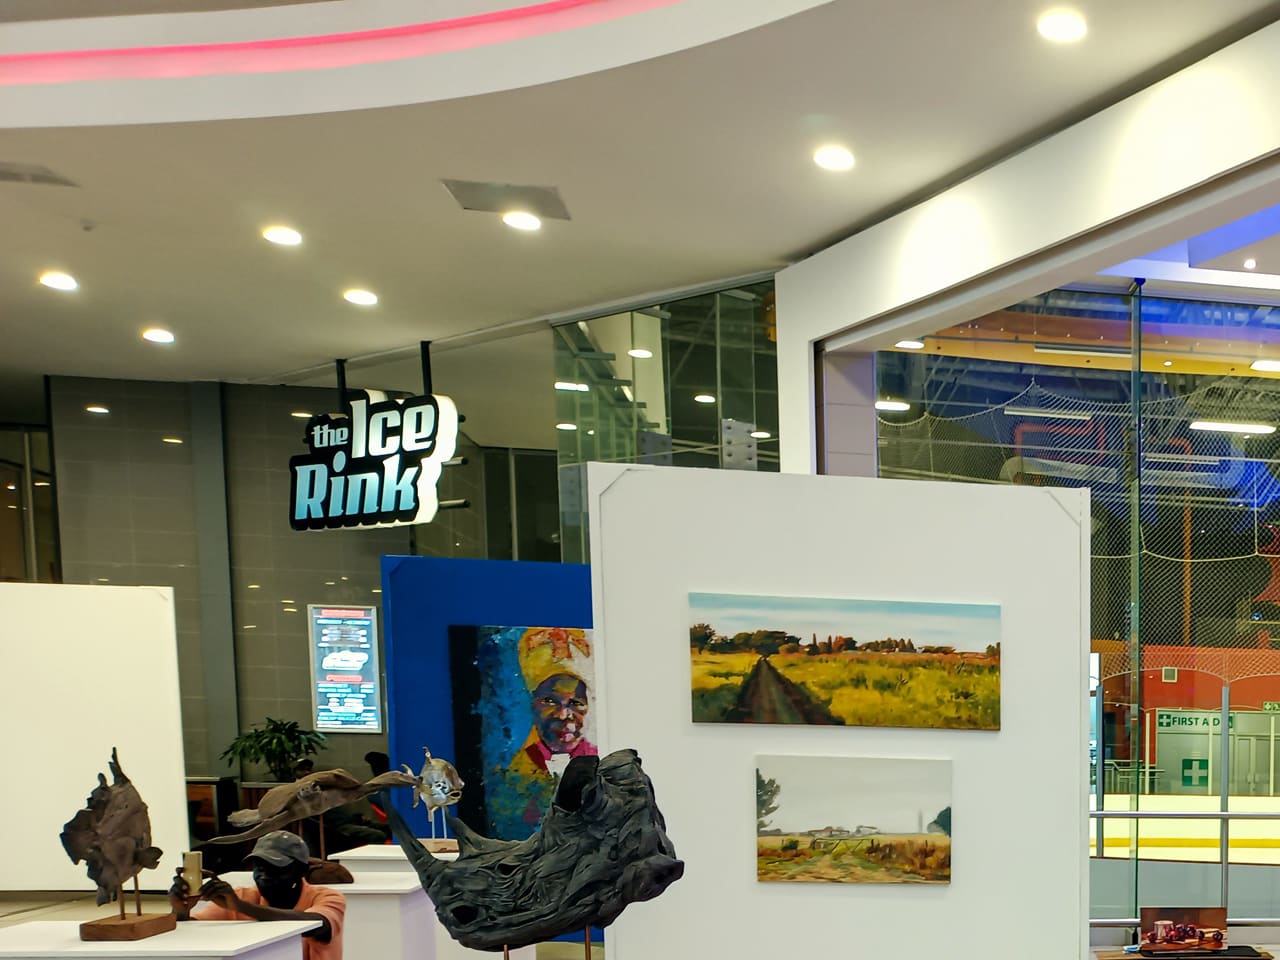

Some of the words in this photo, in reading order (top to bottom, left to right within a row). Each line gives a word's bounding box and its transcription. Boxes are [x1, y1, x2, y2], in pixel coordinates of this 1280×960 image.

[311, 423, 349, 448] the
[350, 399, 436, 459] Ice
[294, 450, 419, 520] Rink
[1172, 716, 1199, 726] FIRST
[1202, 717, 1220, 726] AD
